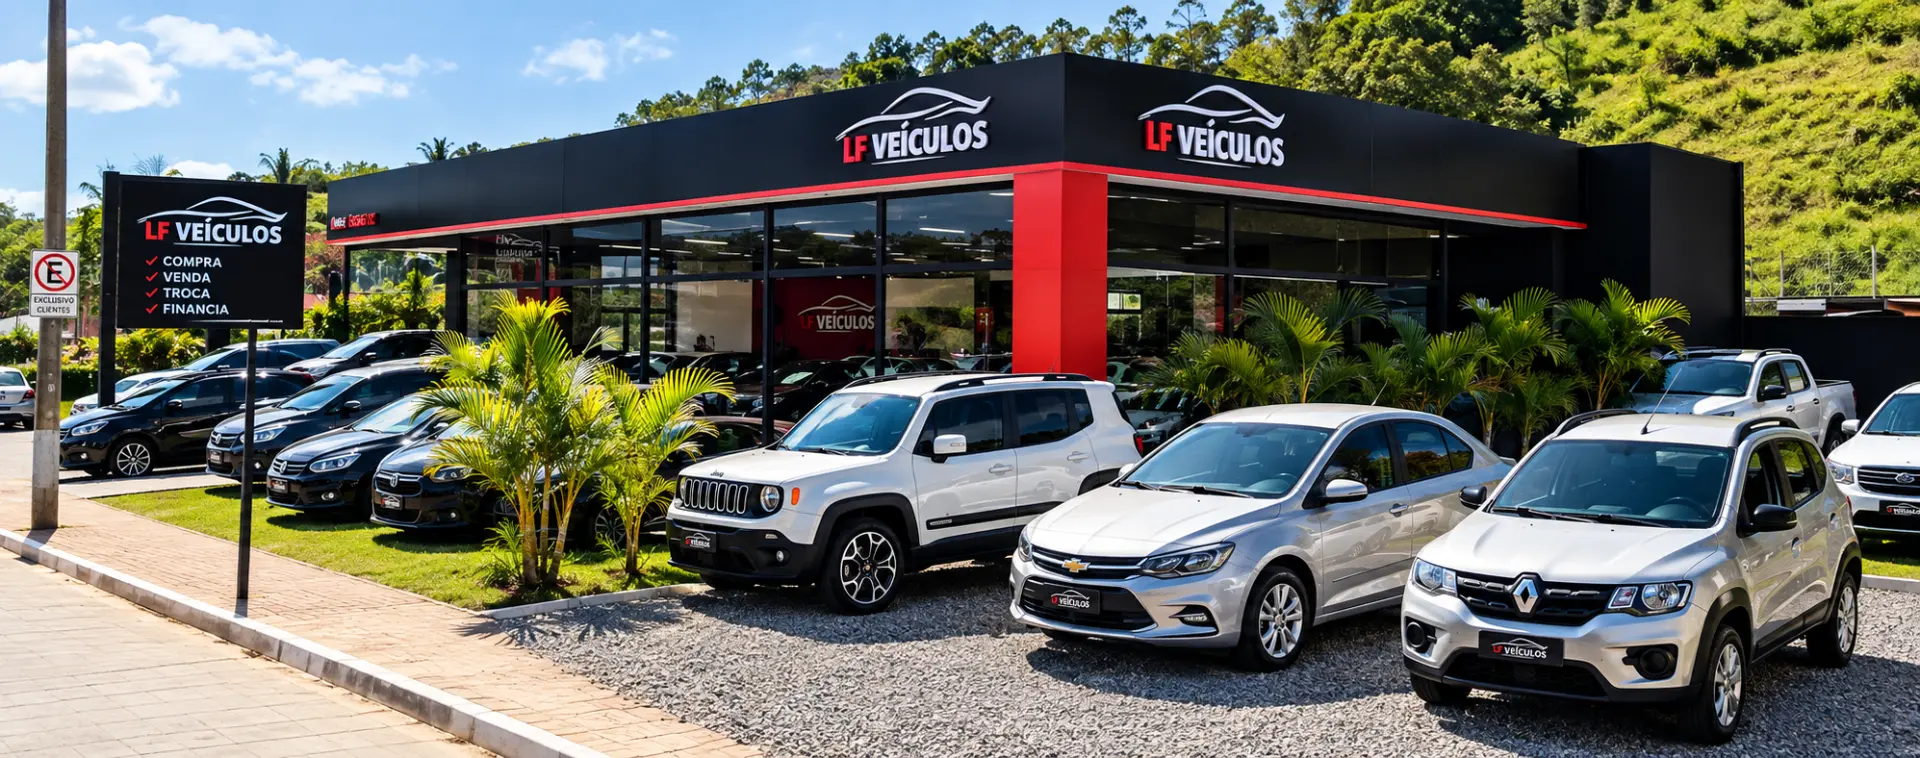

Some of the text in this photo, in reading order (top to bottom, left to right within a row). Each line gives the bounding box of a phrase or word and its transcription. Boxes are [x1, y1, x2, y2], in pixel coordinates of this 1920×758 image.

[843, 120, 988, 164] LF VEÍCULOS
[1145, 118, 1285, 167] LF VEÍCULOS
[145, 217, 282, 244] LF VEÍCULOS
[163, 256, 222, 268] COMPRA
[47, 261, 63, 283] E
[163, 271, 211, 283] VENDA
[163, 287, 211, 299] TROCA
[33, 296, 75, 304] EXCLUSIVO
[36, 306, 71, 314] CLIENTES
[163, 303, 229, 315] FINANCIA
[816, 310, 875, 330] VEÍCULOS
